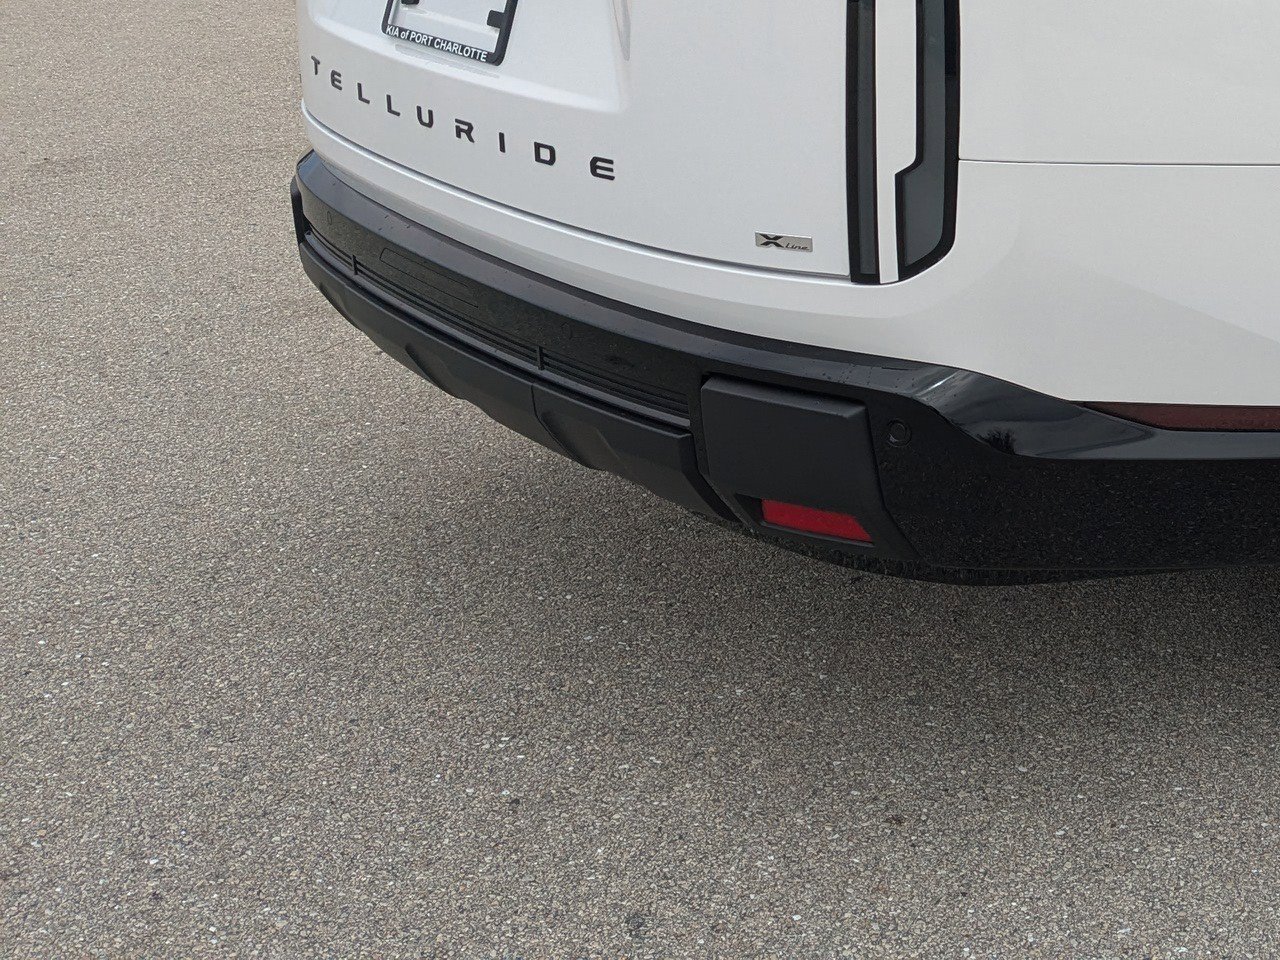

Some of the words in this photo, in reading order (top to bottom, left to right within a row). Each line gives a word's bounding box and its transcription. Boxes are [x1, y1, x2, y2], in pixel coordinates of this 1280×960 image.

[386, 25, 399, 38] KIA
[400, 29, 410, 40] of
[409, 31, 433, 46] PORT
[434, 38, 488, 62] CHARLOTTE
[310, 55, 615, 181] TELLURIDE
[759, 233, 784, 248] X
